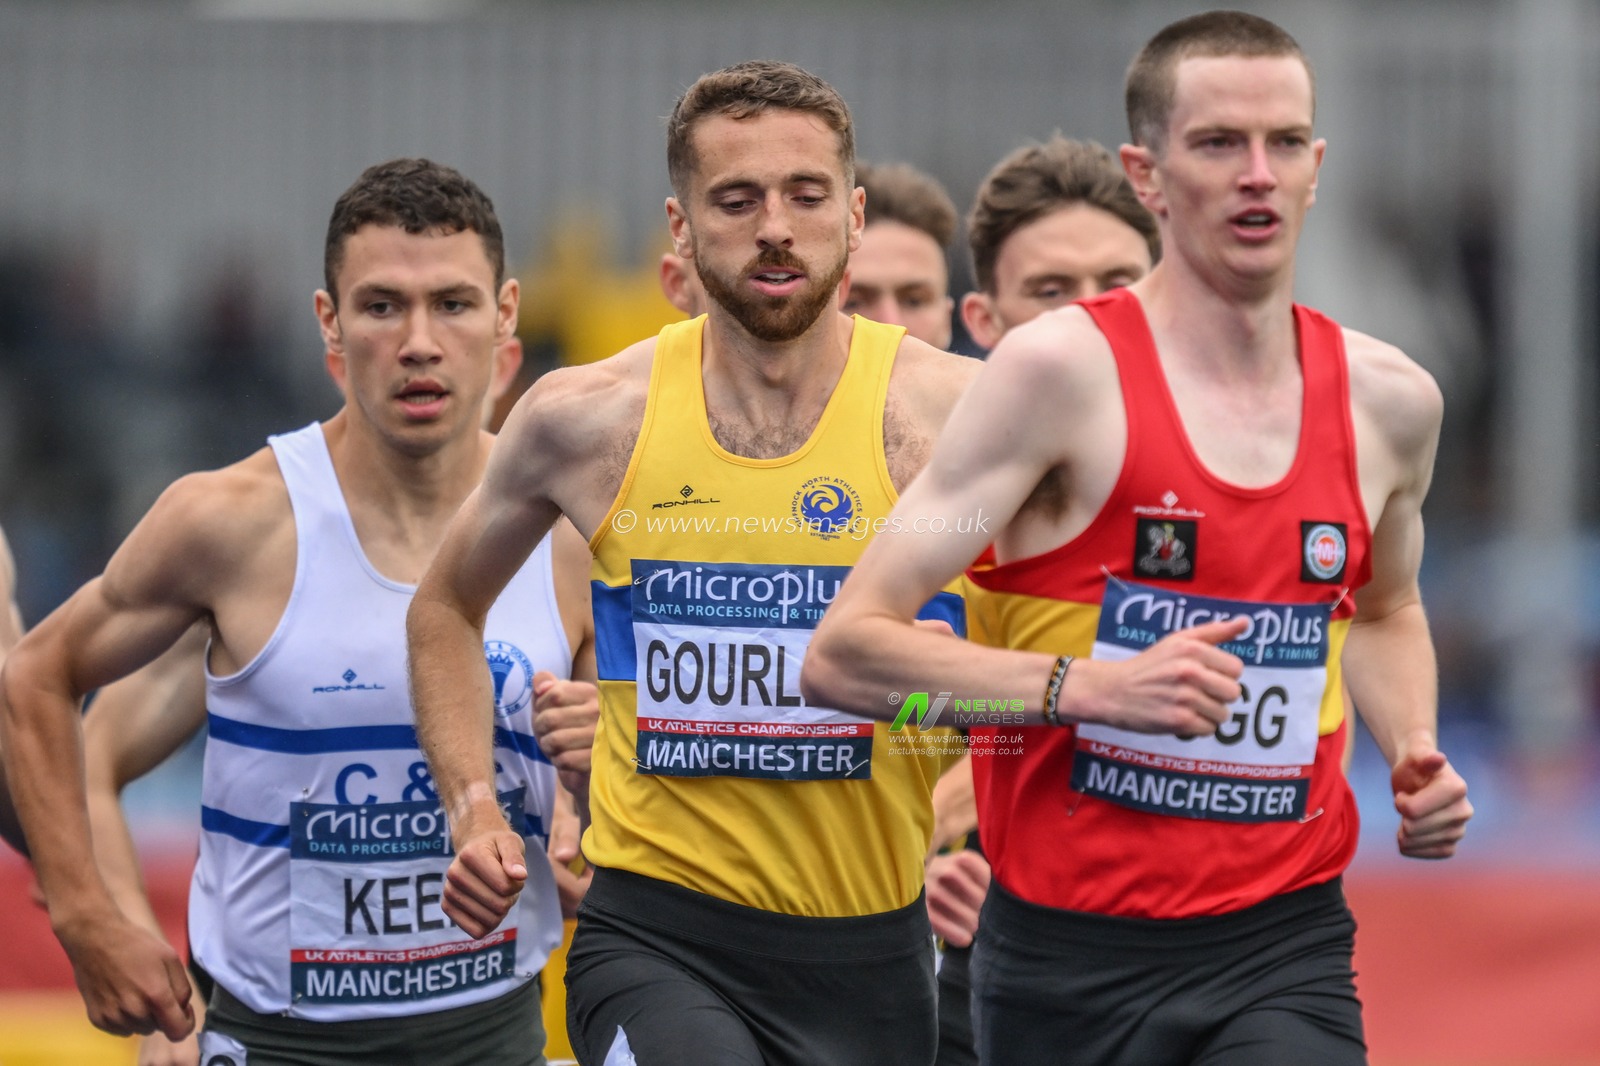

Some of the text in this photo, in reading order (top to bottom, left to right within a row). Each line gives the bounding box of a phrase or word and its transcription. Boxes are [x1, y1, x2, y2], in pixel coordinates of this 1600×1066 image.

[652, 498, 720, 510] RONHILL
[801, 476, 830, 489] NORTH
[833, 478, 863, 512] ATHLETICS
[1132, 506, 1206, 518] RONHILL
[649, 603, 682, 616] DATA
[687, 606, 780, 618] PROCESSING
[790, 608, 800, 619] &
[1116, 626, 1157, 644] DATA
[1264, 646, 1274, 659] &
[1278, 647, 1320, 660] TIMING
[647, 639, 812, 708] GOURL
[313, 684, 386, 694] RONHILL
[648, 720, 858, 735] UK ATHLETICS CHAMPIONSHIPS
[647, 740, 854, 772] MANCHESTER
[1090, 742, 1302, 778] UK ATHLETICS CHAMPIONSHIPS
[1086, 762, 1297, 816] MANCHESTER
[309, 840, 442, 855] DATA PROCESSING
[344, 872, 450, 935] KEE
[305, 932, 505, 962] UK ATHLETICS CHAMPIONSHIPS
[306, 950, 503, 997] MANCHESTER
